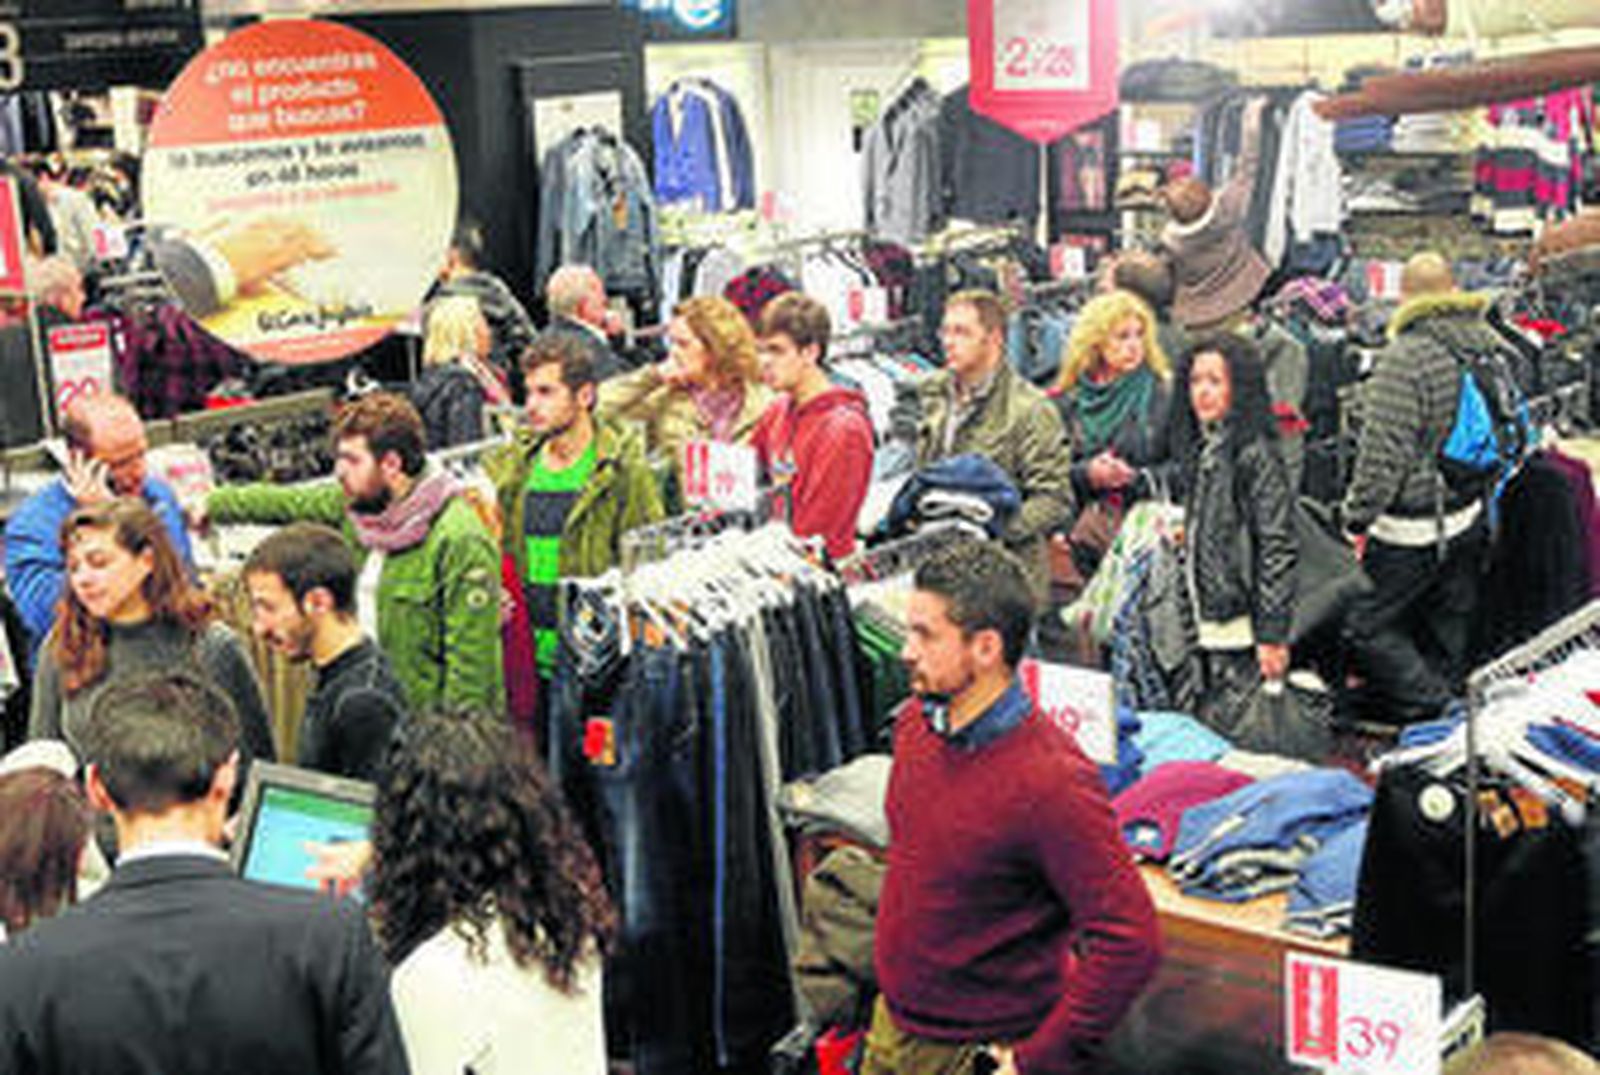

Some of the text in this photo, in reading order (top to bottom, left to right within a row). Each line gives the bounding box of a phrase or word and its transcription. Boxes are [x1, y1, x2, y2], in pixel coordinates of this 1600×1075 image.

[253, 53, 376, 78] encuentras
[258, 77, 358, 107] producto
[1344, 1015, 1403, 1063] 39
